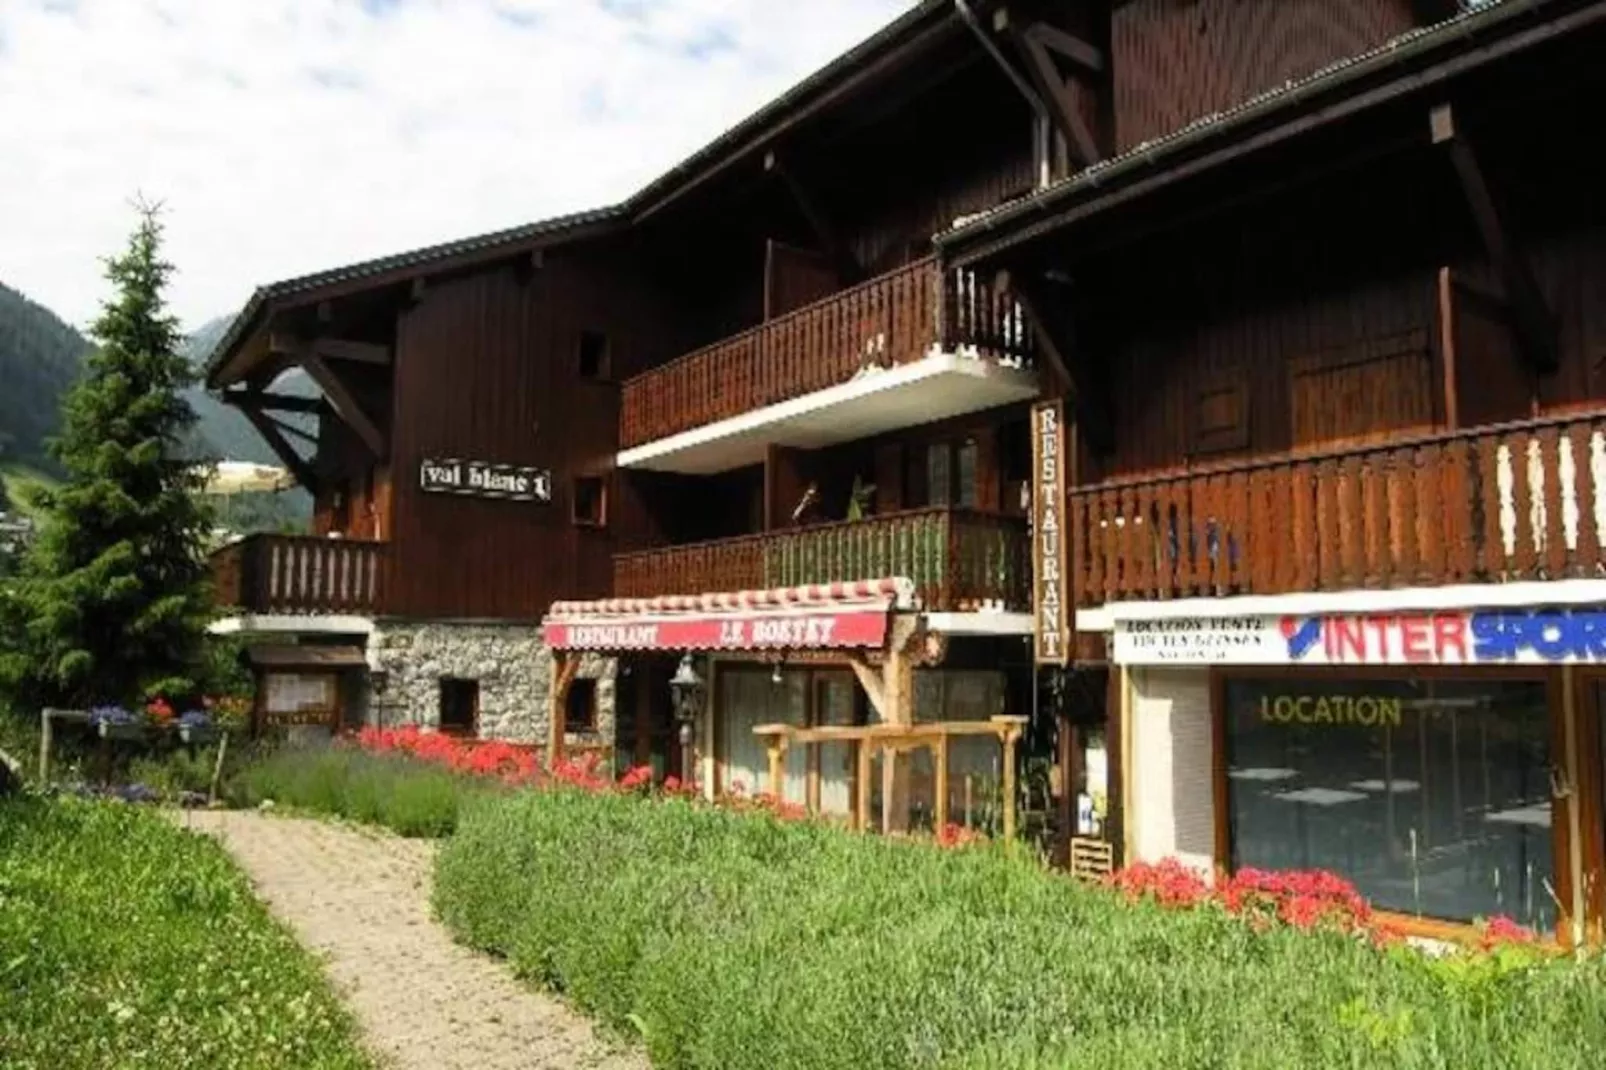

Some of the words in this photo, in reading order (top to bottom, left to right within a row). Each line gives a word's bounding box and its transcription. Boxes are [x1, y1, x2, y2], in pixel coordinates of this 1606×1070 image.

[426, 465, 461, 486] val
[1040, 408, 1060, 657] RESTAURANT
[565, 624, 658, 646] RESTAURANT
[1260, 695, 1401, 725] LOCATION
